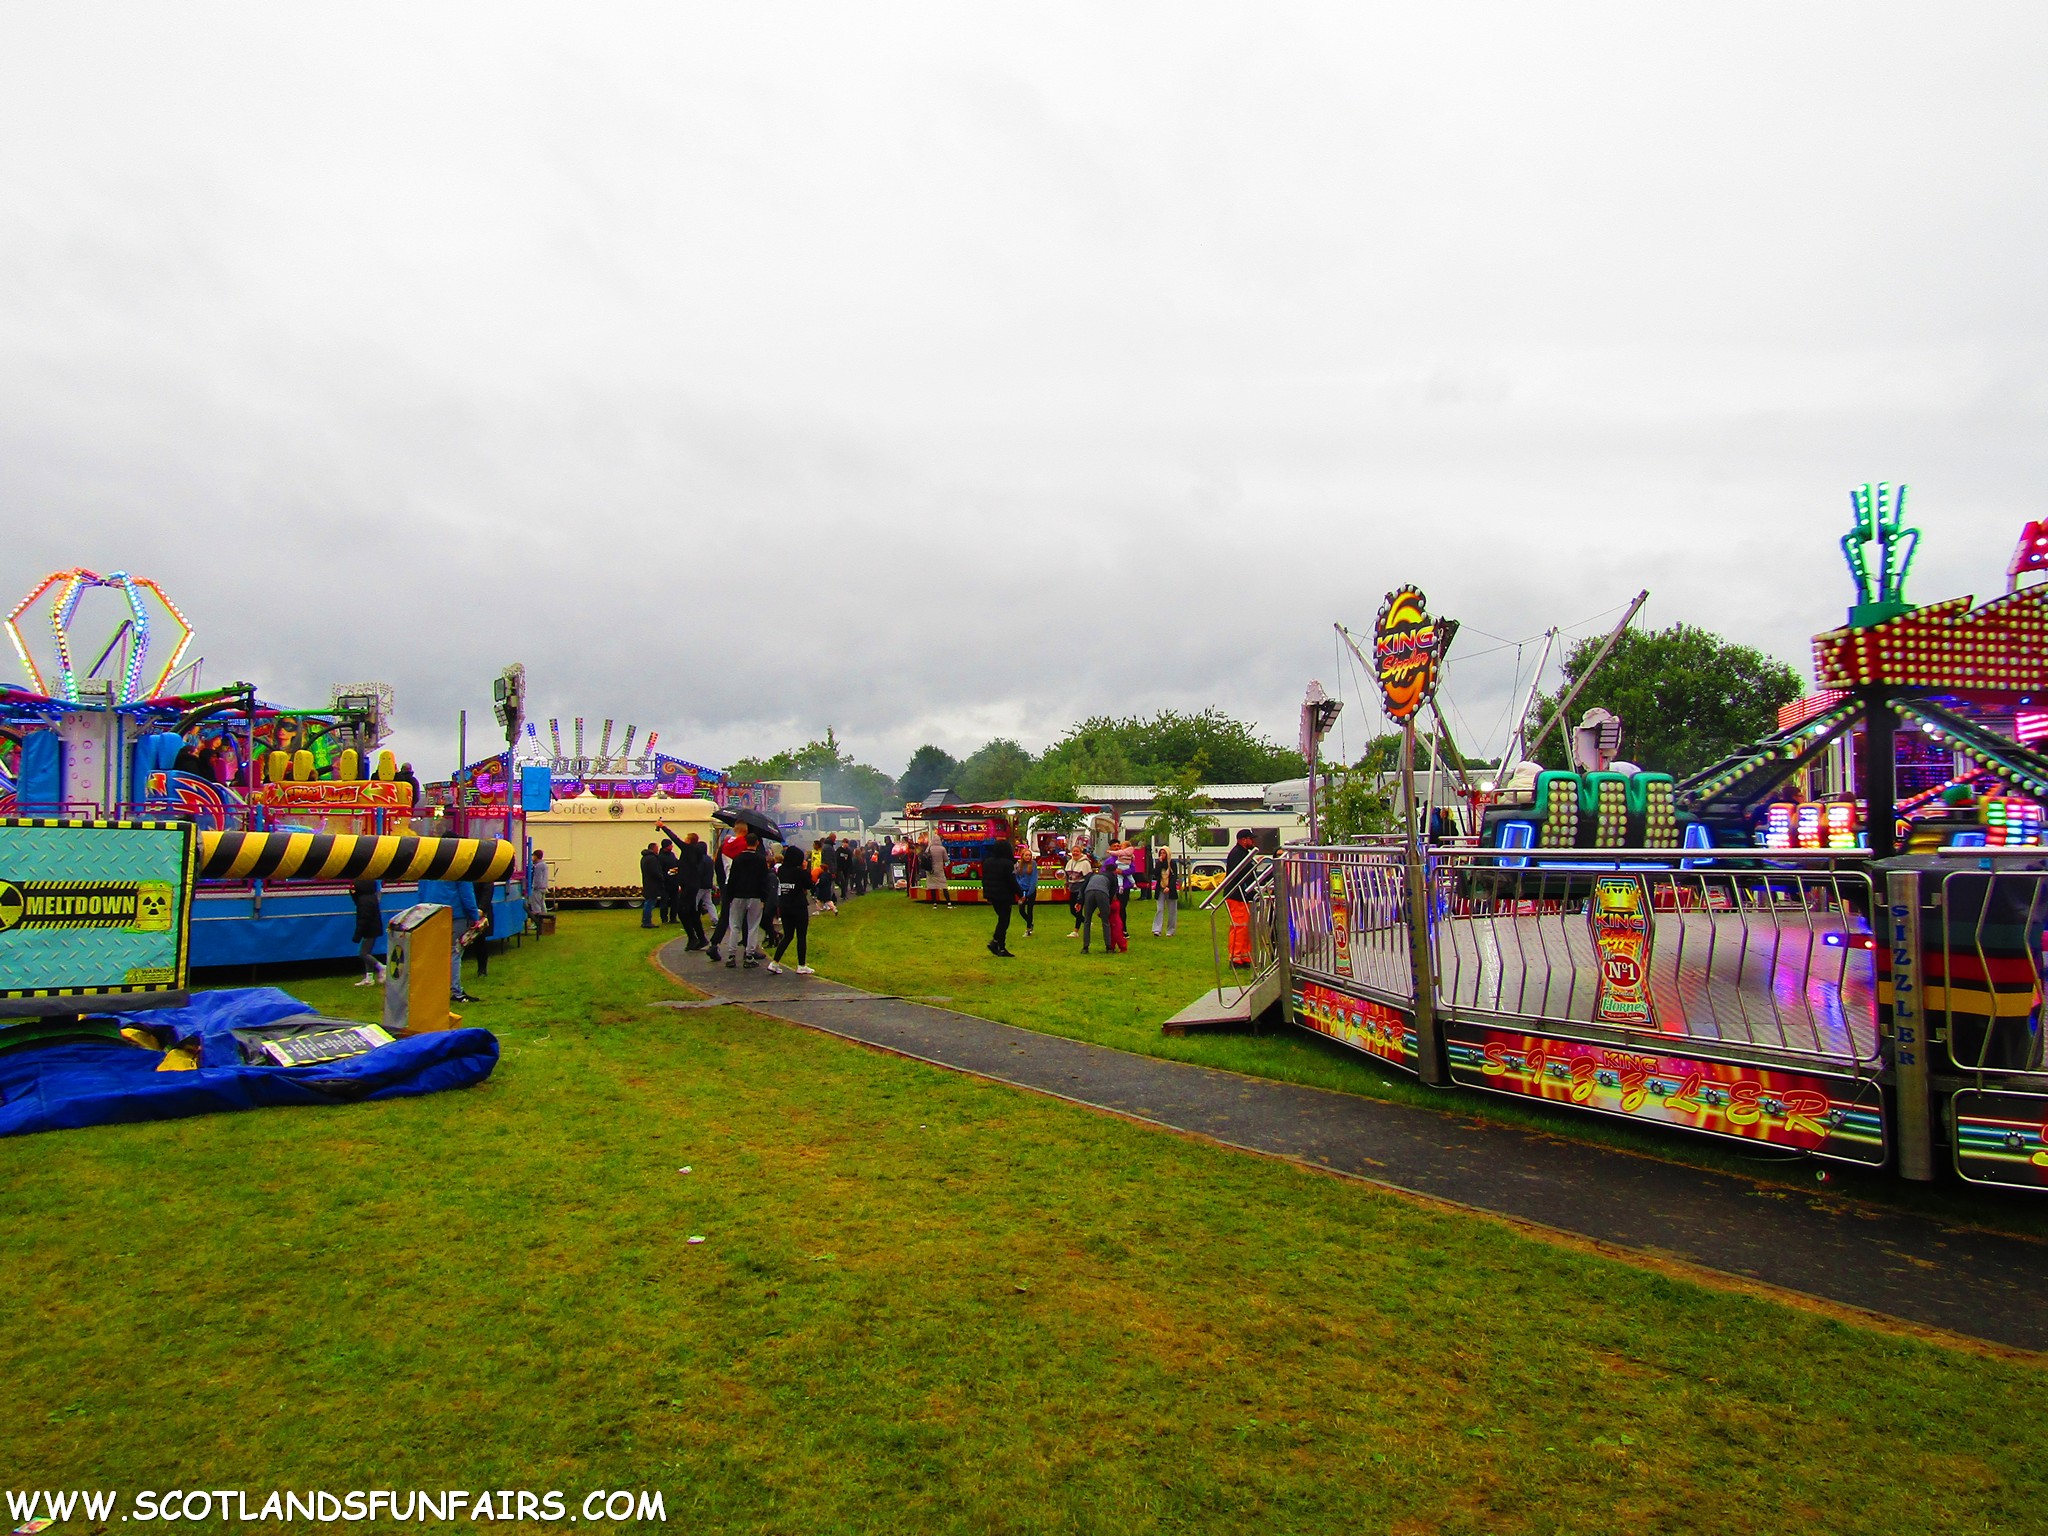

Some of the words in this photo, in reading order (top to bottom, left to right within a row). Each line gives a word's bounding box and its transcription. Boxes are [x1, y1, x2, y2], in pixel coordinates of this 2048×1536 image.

[1377, 625, 1434, 657] KING
[1380, 648, 1428, 682] Sizzler
[551, 803, 597, 814] Coffee
[635, 803, 675, 814] Cakes
[26, 896, 135, 915] MELTDOWN
[1595, 913, 1645, 930] KING
[1891, 905, 1916, 1066] SIZZLER
[1602, 1051, 1658, 1074] KING
[1481, 1041, 1828, 1137] SIZZLER
